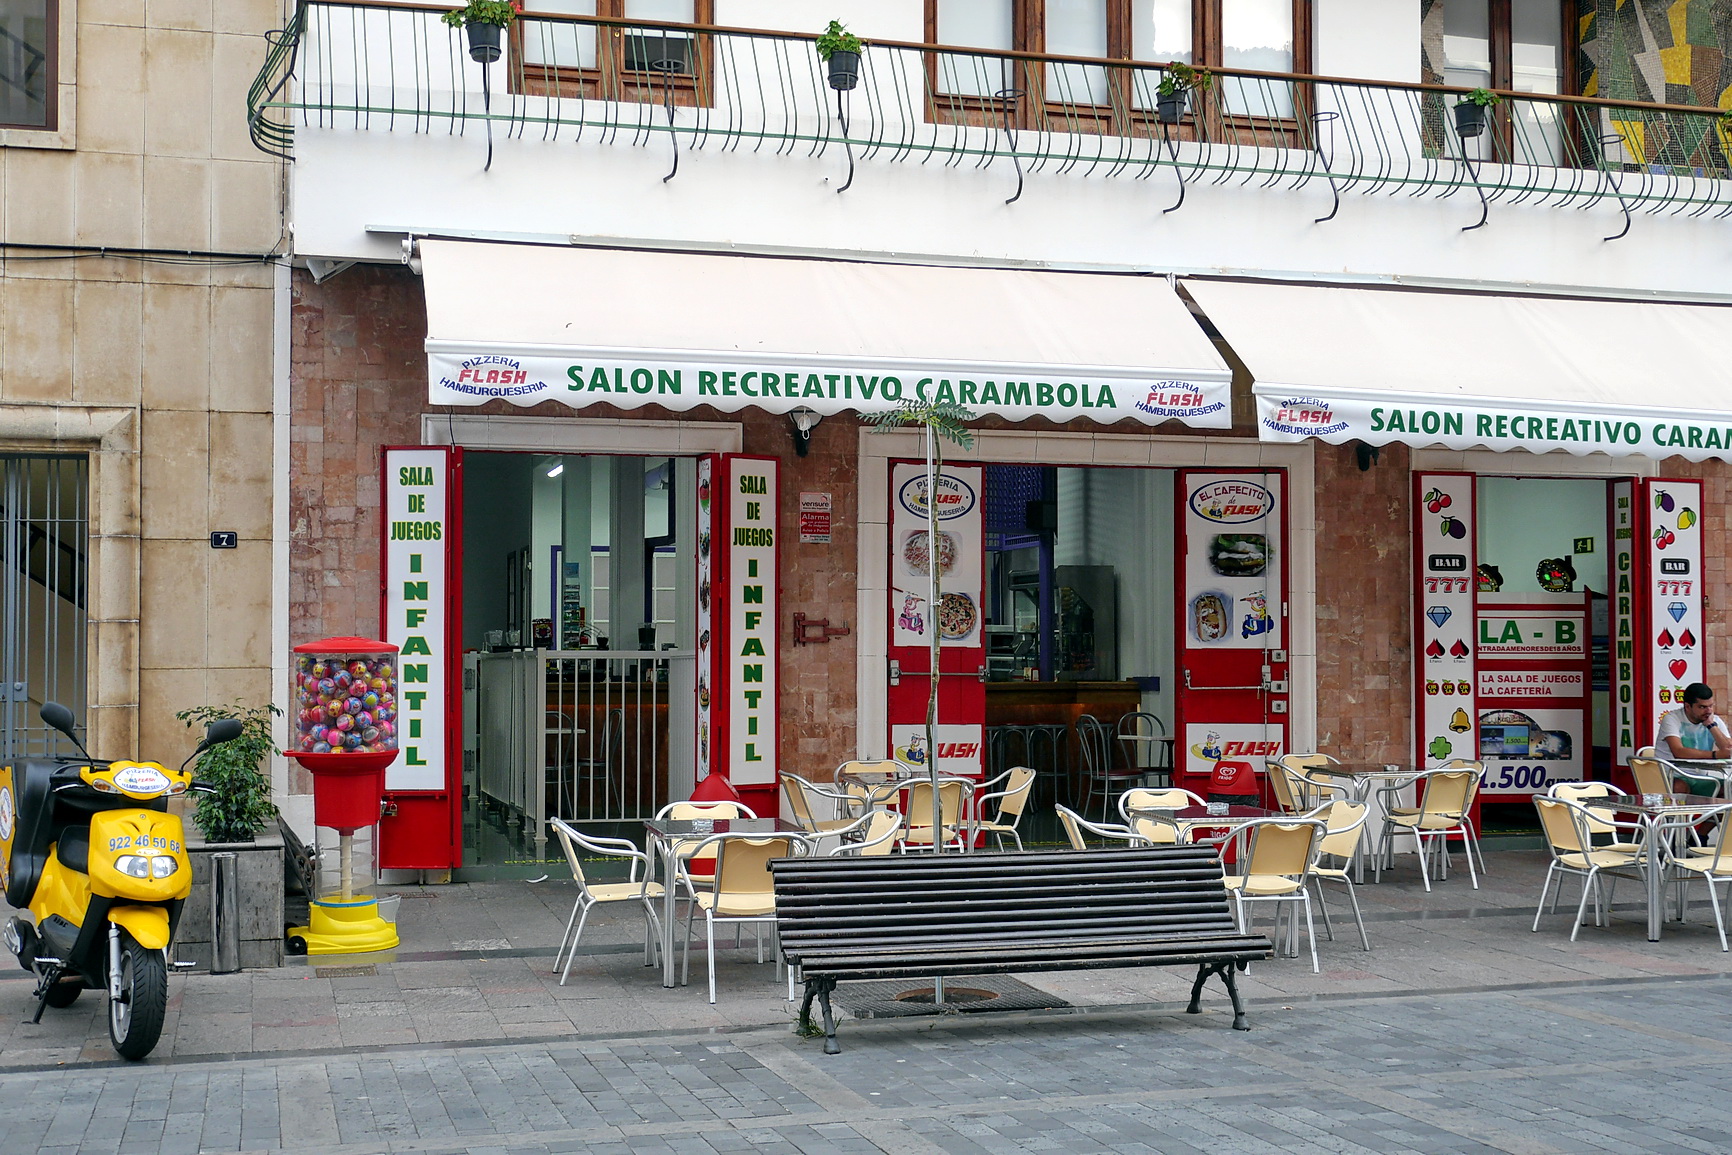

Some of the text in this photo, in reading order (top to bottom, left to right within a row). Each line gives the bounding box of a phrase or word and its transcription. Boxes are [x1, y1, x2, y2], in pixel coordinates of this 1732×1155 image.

[461, 355, 520, 370] PIZZERIA
[458, 369, 527, 384] FLASH
[439, 377, 548, 396] HAMBURGUESERIA
[567, 365, 1117, 409] SALON RECREATIVO CARAMBOLA
[1150, 380, 1199, 394] PIZZERIA
[1146, 392, 1204, 406] FLASH
[1281, 397, 1329, 411] PIZZERIA
[1135, 400, 1226, 417] HAMBURGUESERIA
[1276, 409, 1333, 424] FLASH
[1263, 416, 1350, 436] HAMBURGUESERIA
[1370, 407, 1463, 435] SALON
[1476, 414, 1642, 445] RECREATIVO
[399, 466, 434, 486] SALA
[739, 474, 768, 495] SALA
[916, 478, 959, 493] PIERIA
[1198, 485, 1265, 502] EL CAFECITO
[408, 494, 425, 513] DE
[746, 502, 760, 520] DE
[908, 502, 966, 516] HAMBUESERIA
[1223, 504, 1262, 515] FLASH
[390, 521, 442, 541] JUEGOS
[733, 527, 773, 547] JUEGOS
[219, 534, 228, 546] 7
[1434, 558, 1460, 567] BAR
[1665, 562, 1686, 571] BAR
[1425, 576, 1470, 594] 777
[1657, 579, 1693, 596] 777
[1480, 619, 1523, 644] LA
[1555, 620, 1577, 644] B
[1617, 552, 1632, 748] CARAMBOLA
[399, 553, 432, 766] INFANTIL
[740, 558, 766, 762] INFANTIL
[1481, 675, 1582, 683] LA SALA DE JUEGOS
[1481, 685, 1552, 695] LA CAFETERÍA
[938, 742, 979, 758] LASH
[1222, 741, 1282, 756] FLASH
[1480, 765, 1547, 789] 1.500
[109, 834, 180, 854] 922 46 50 68
